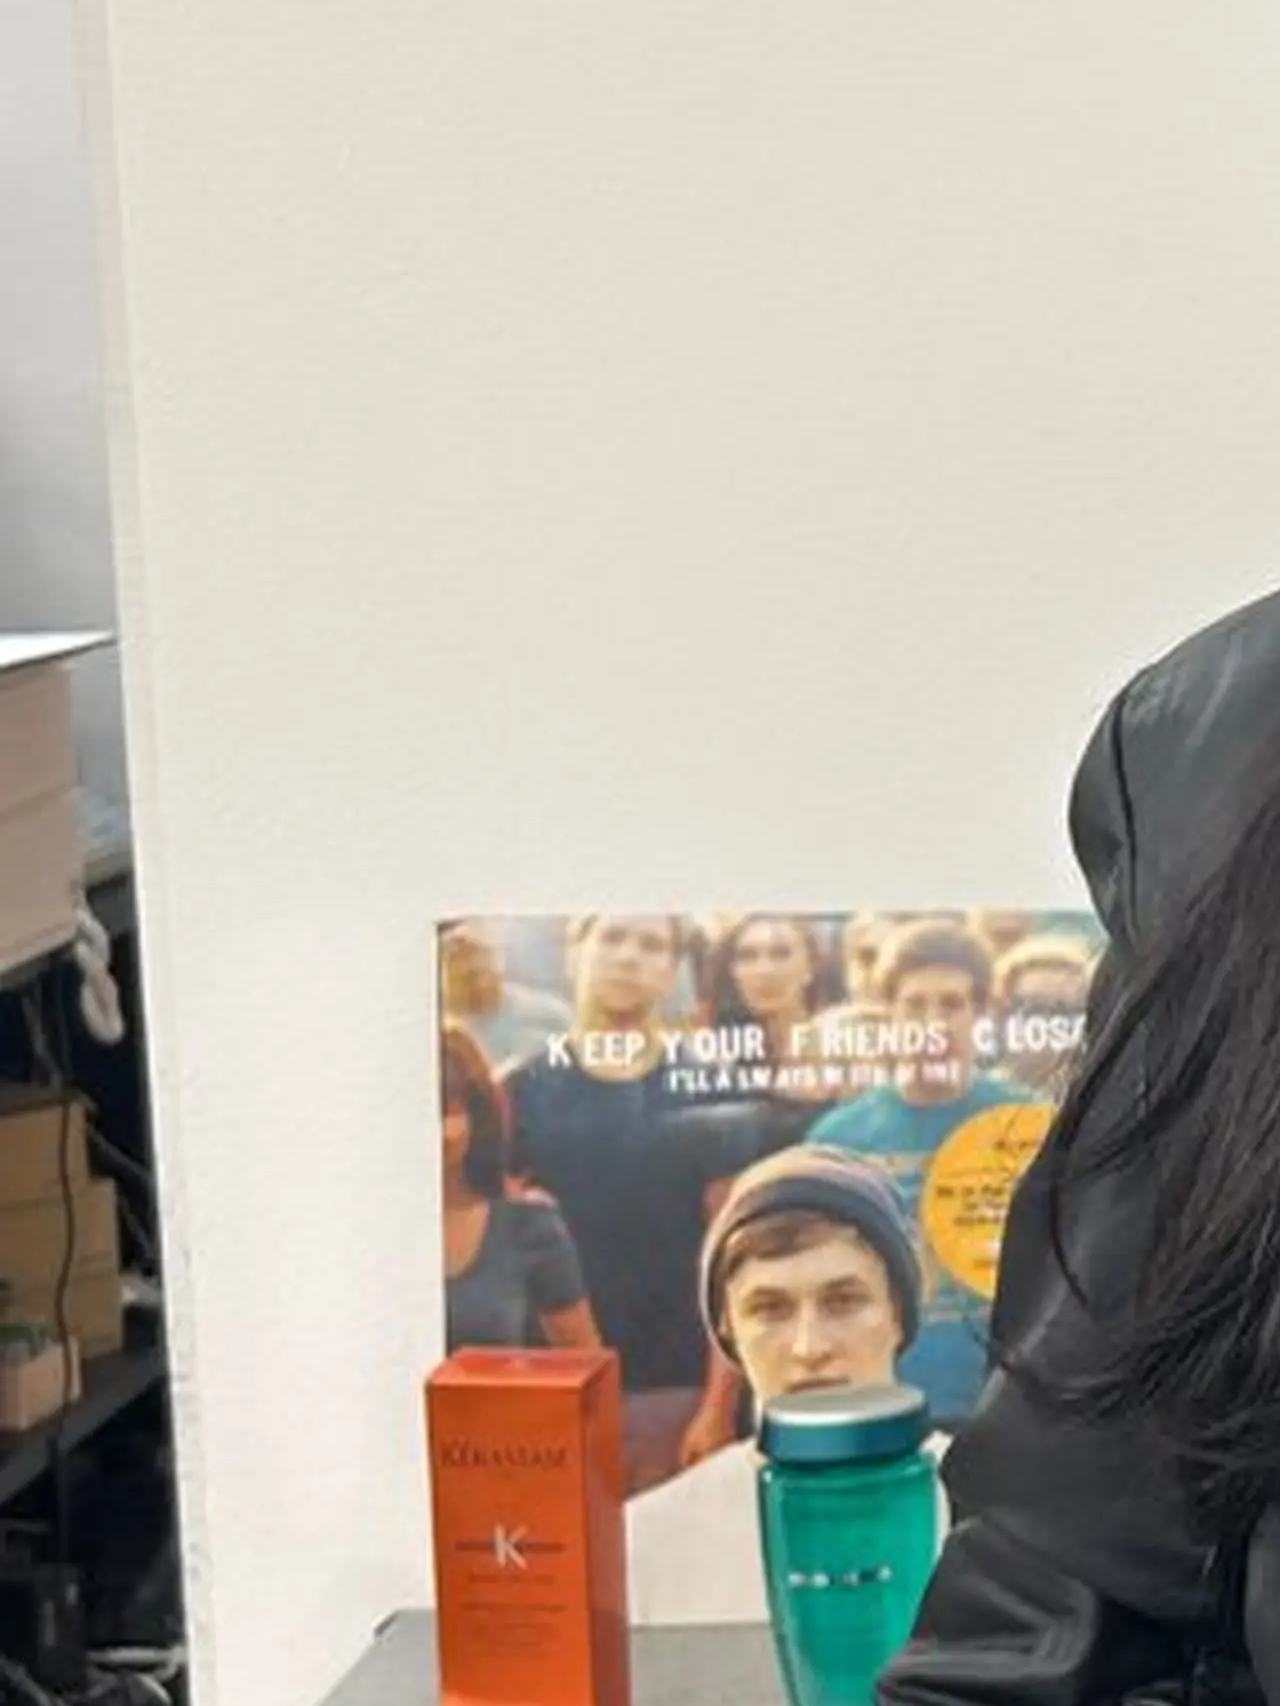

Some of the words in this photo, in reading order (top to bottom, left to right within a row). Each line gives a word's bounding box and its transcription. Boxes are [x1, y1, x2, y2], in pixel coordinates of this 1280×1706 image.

[546, 1029, 646, 1067] KEEP
[657, 1023, 766, 1066] YOUR
[791, 1019, 949, 1058] FRIENDS
[493, 1524, 529, 1570] K
